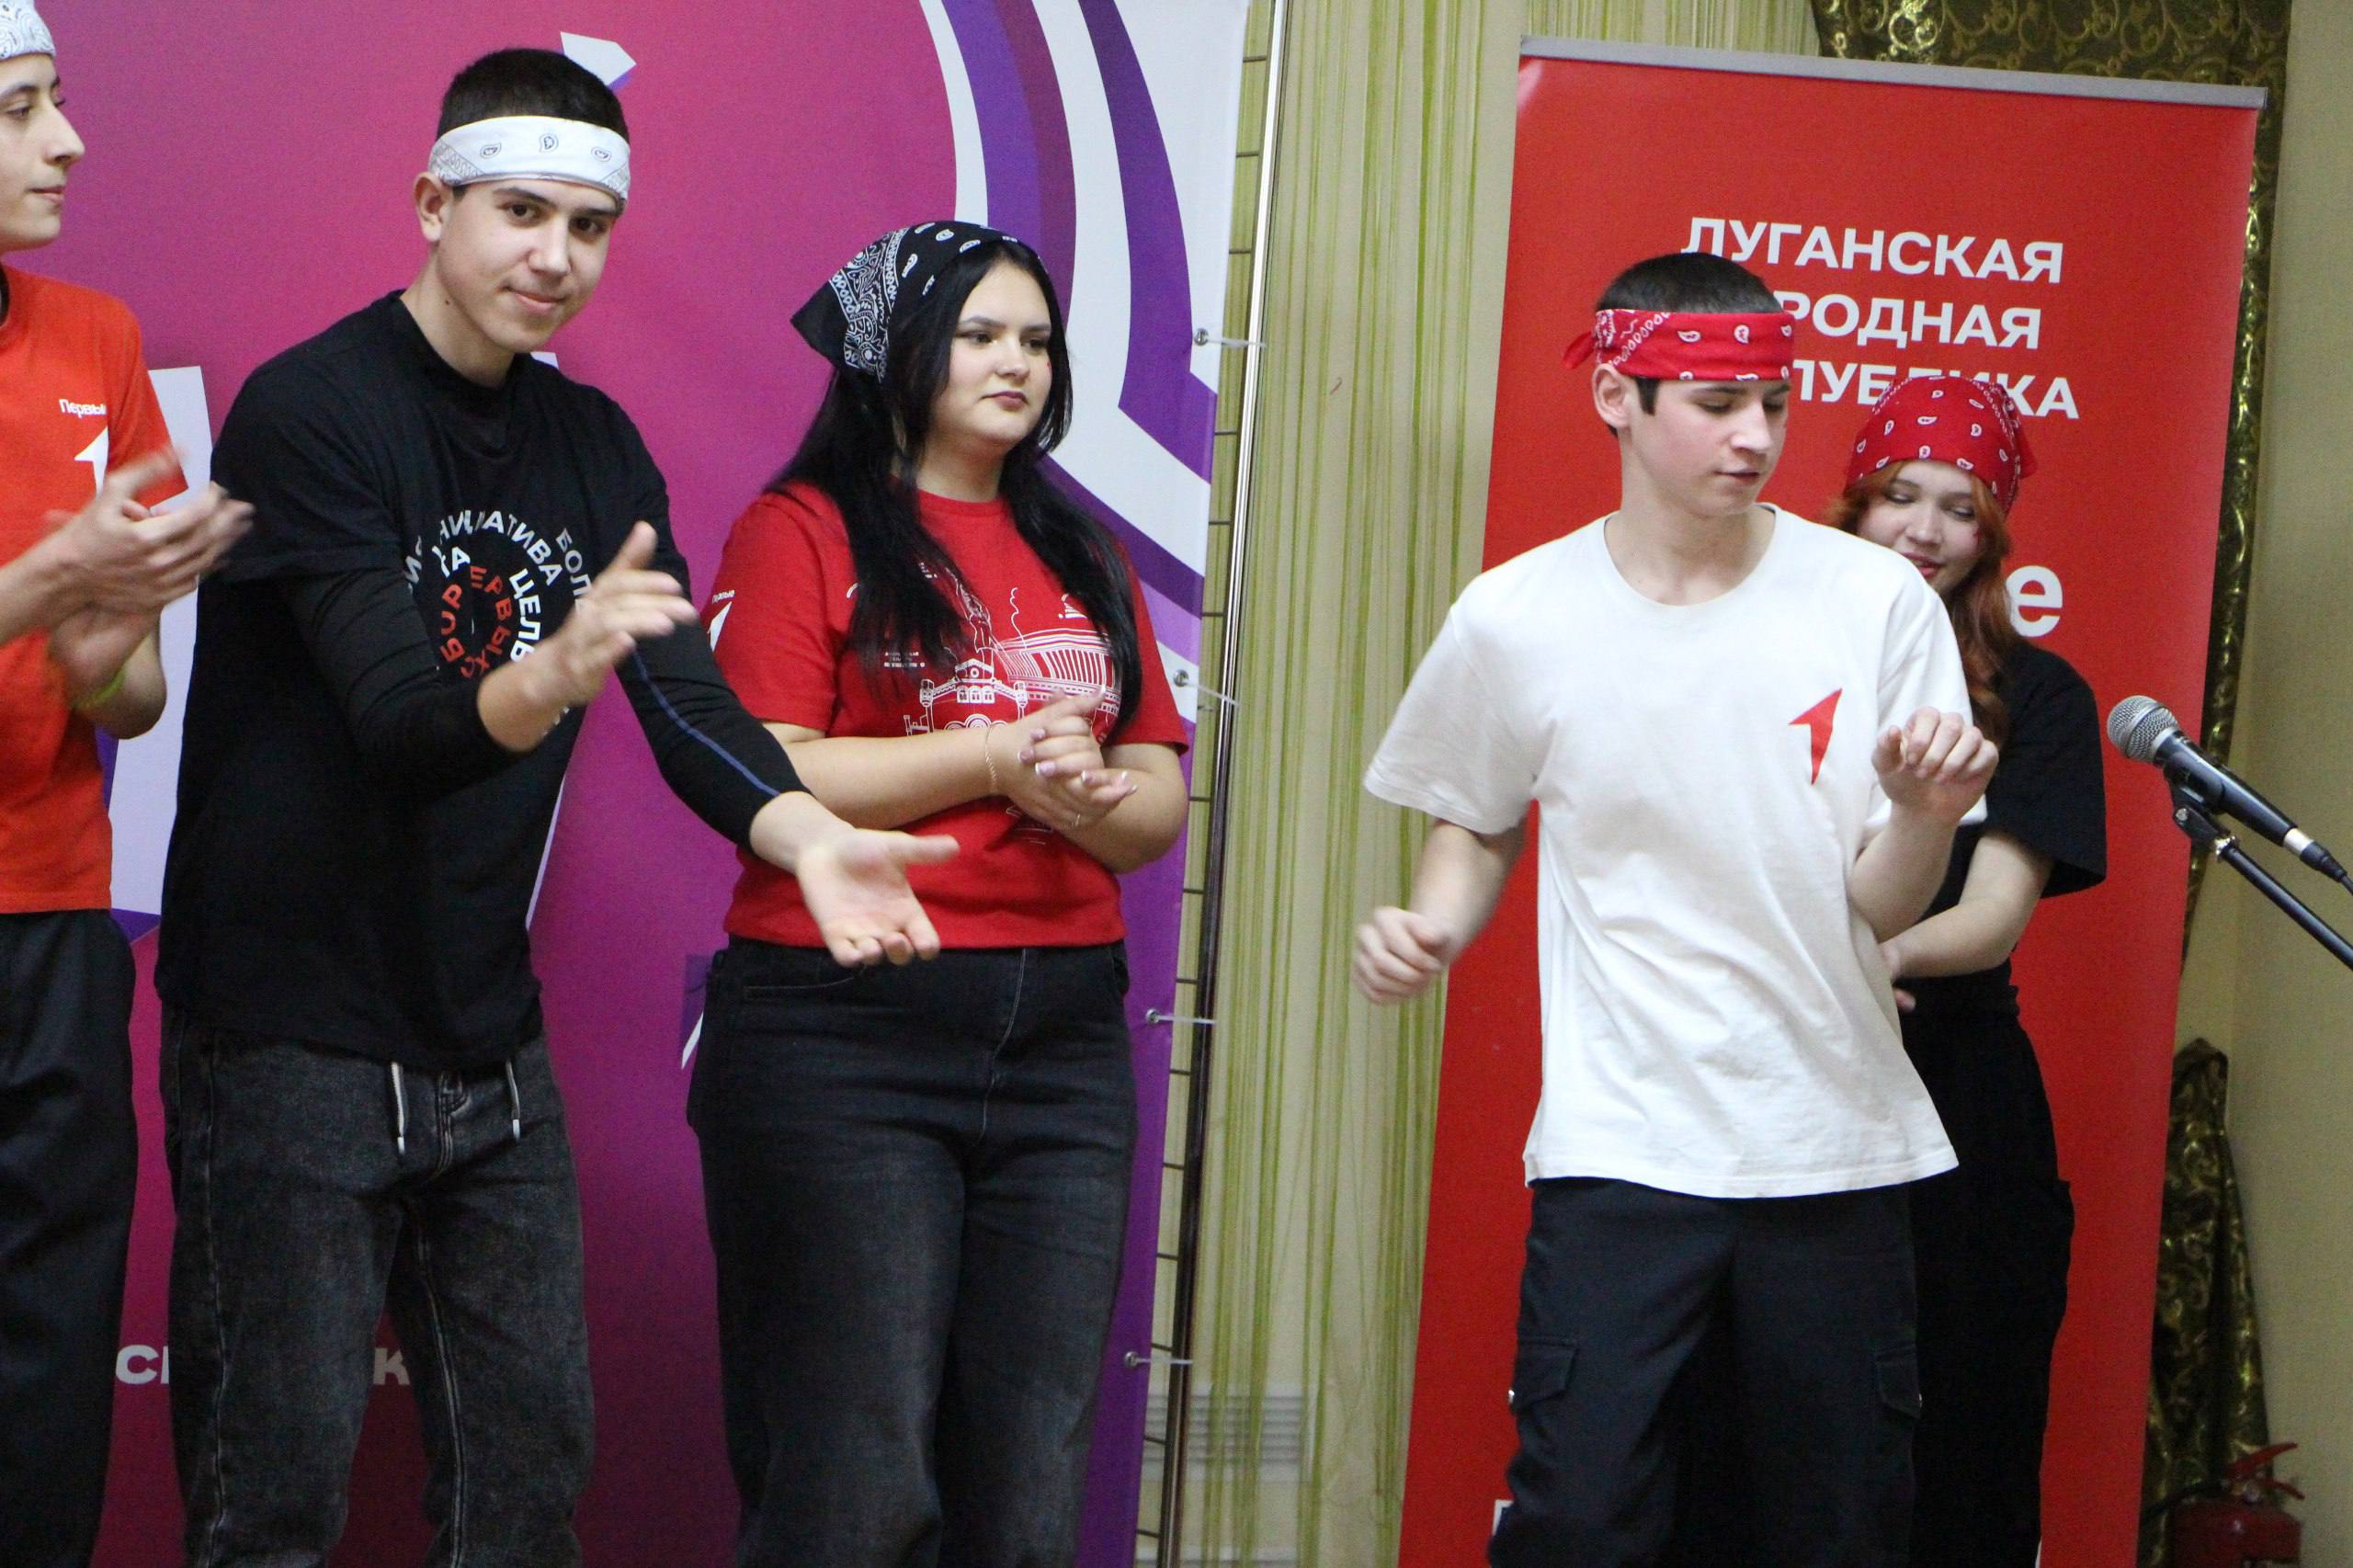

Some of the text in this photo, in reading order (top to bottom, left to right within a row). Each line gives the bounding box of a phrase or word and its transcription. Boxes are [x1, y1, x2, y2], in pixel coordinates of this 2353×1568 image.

[1680, 216, 2063, 284] ЛУГАНСКАЯ
[1773, 290, 2041, 349] РОДНАЯ
[470, 565, 512, 676] ЕРВЫХ
[508, 568, 541, 662] ЦЕЛЬ
